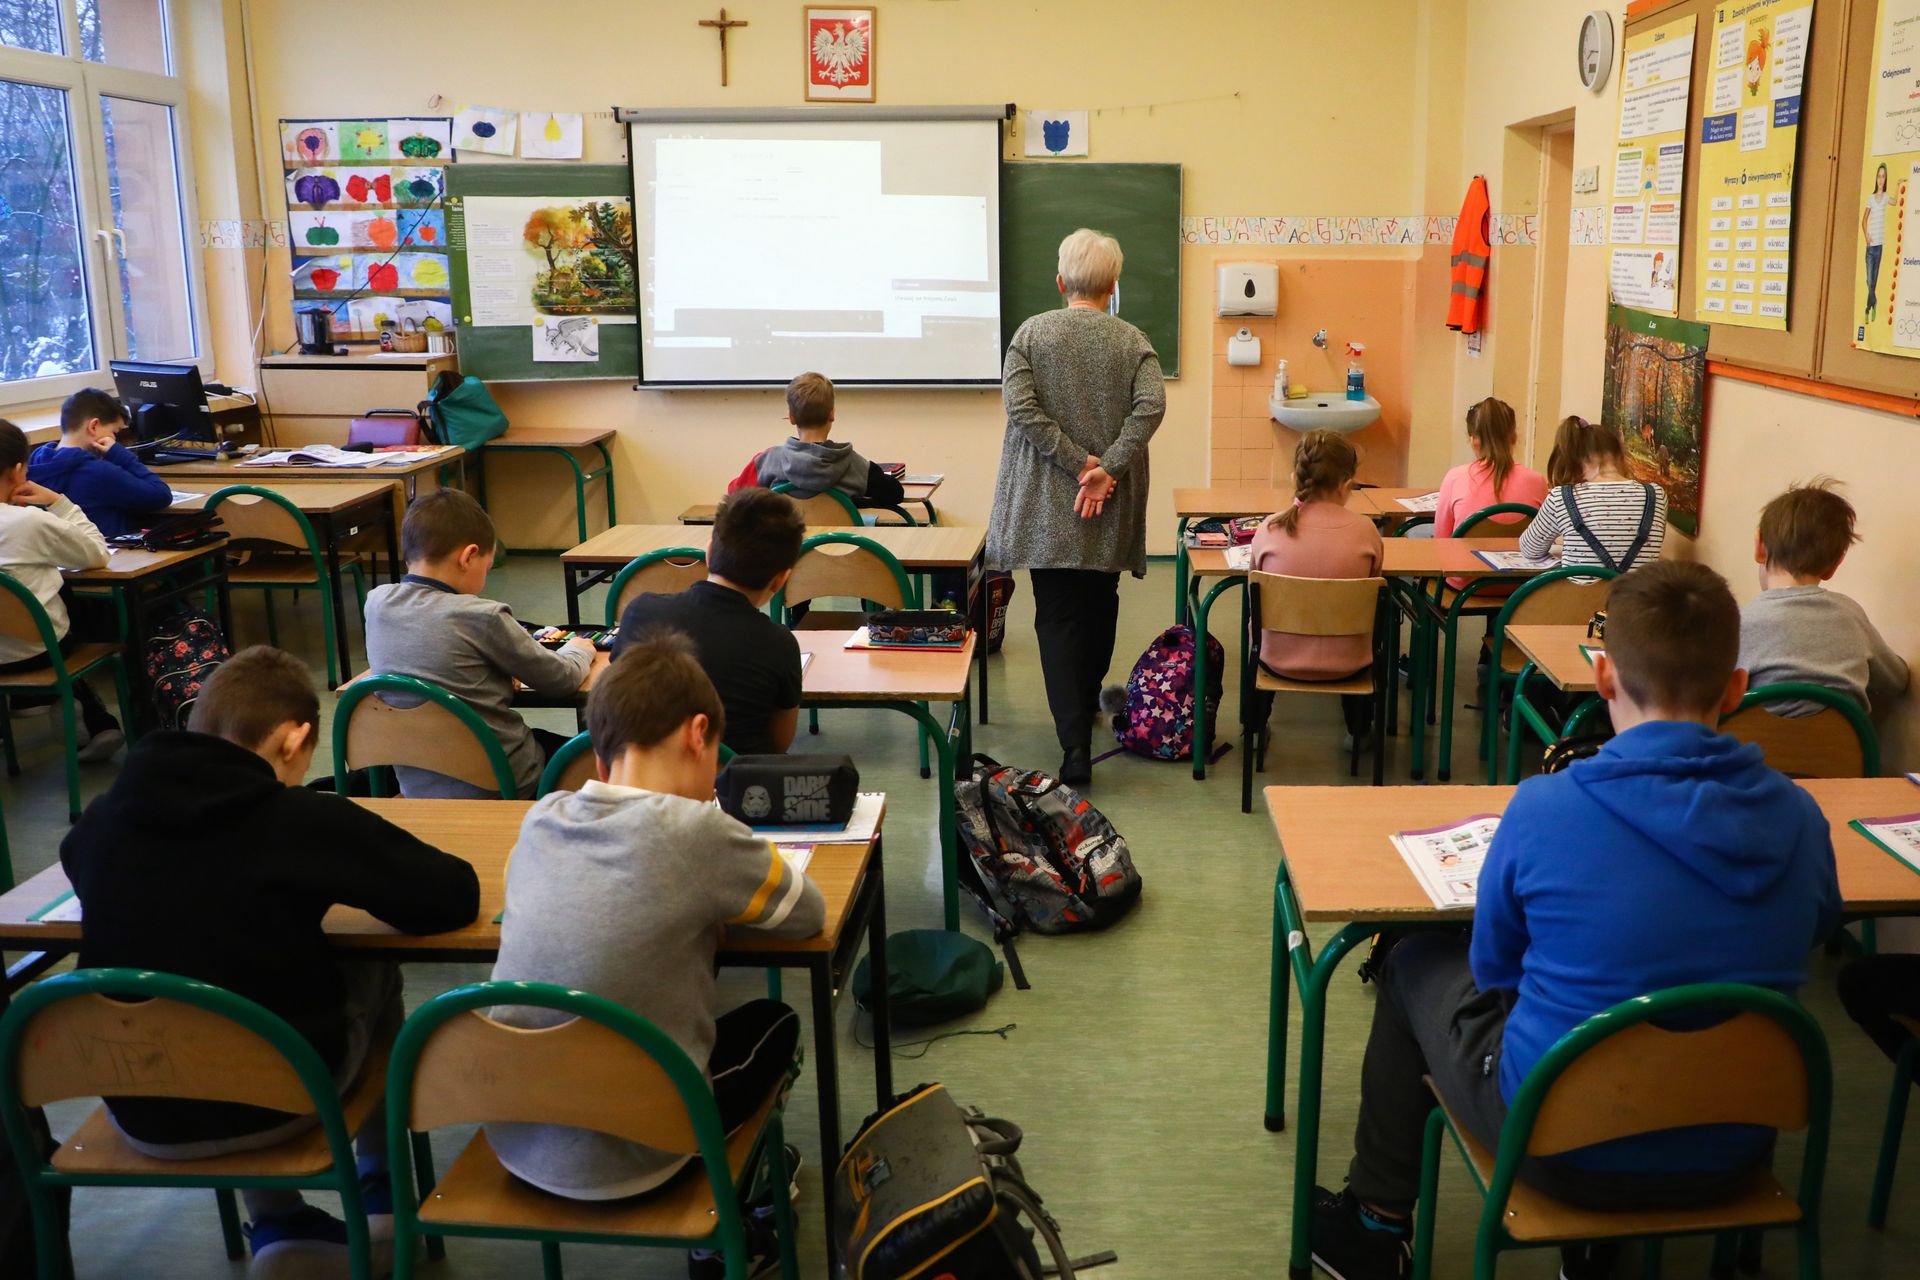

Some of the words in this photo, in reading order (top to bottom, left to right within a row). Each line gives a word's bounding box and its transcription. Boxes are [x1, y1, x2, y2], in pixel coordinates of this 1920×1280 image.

[1648, 320, 1656, 329] Las
[140, 380, 157, 388] ASUS
[784, 775, 831, 799] DARK
[783, 796, 830, 822] SIDE
